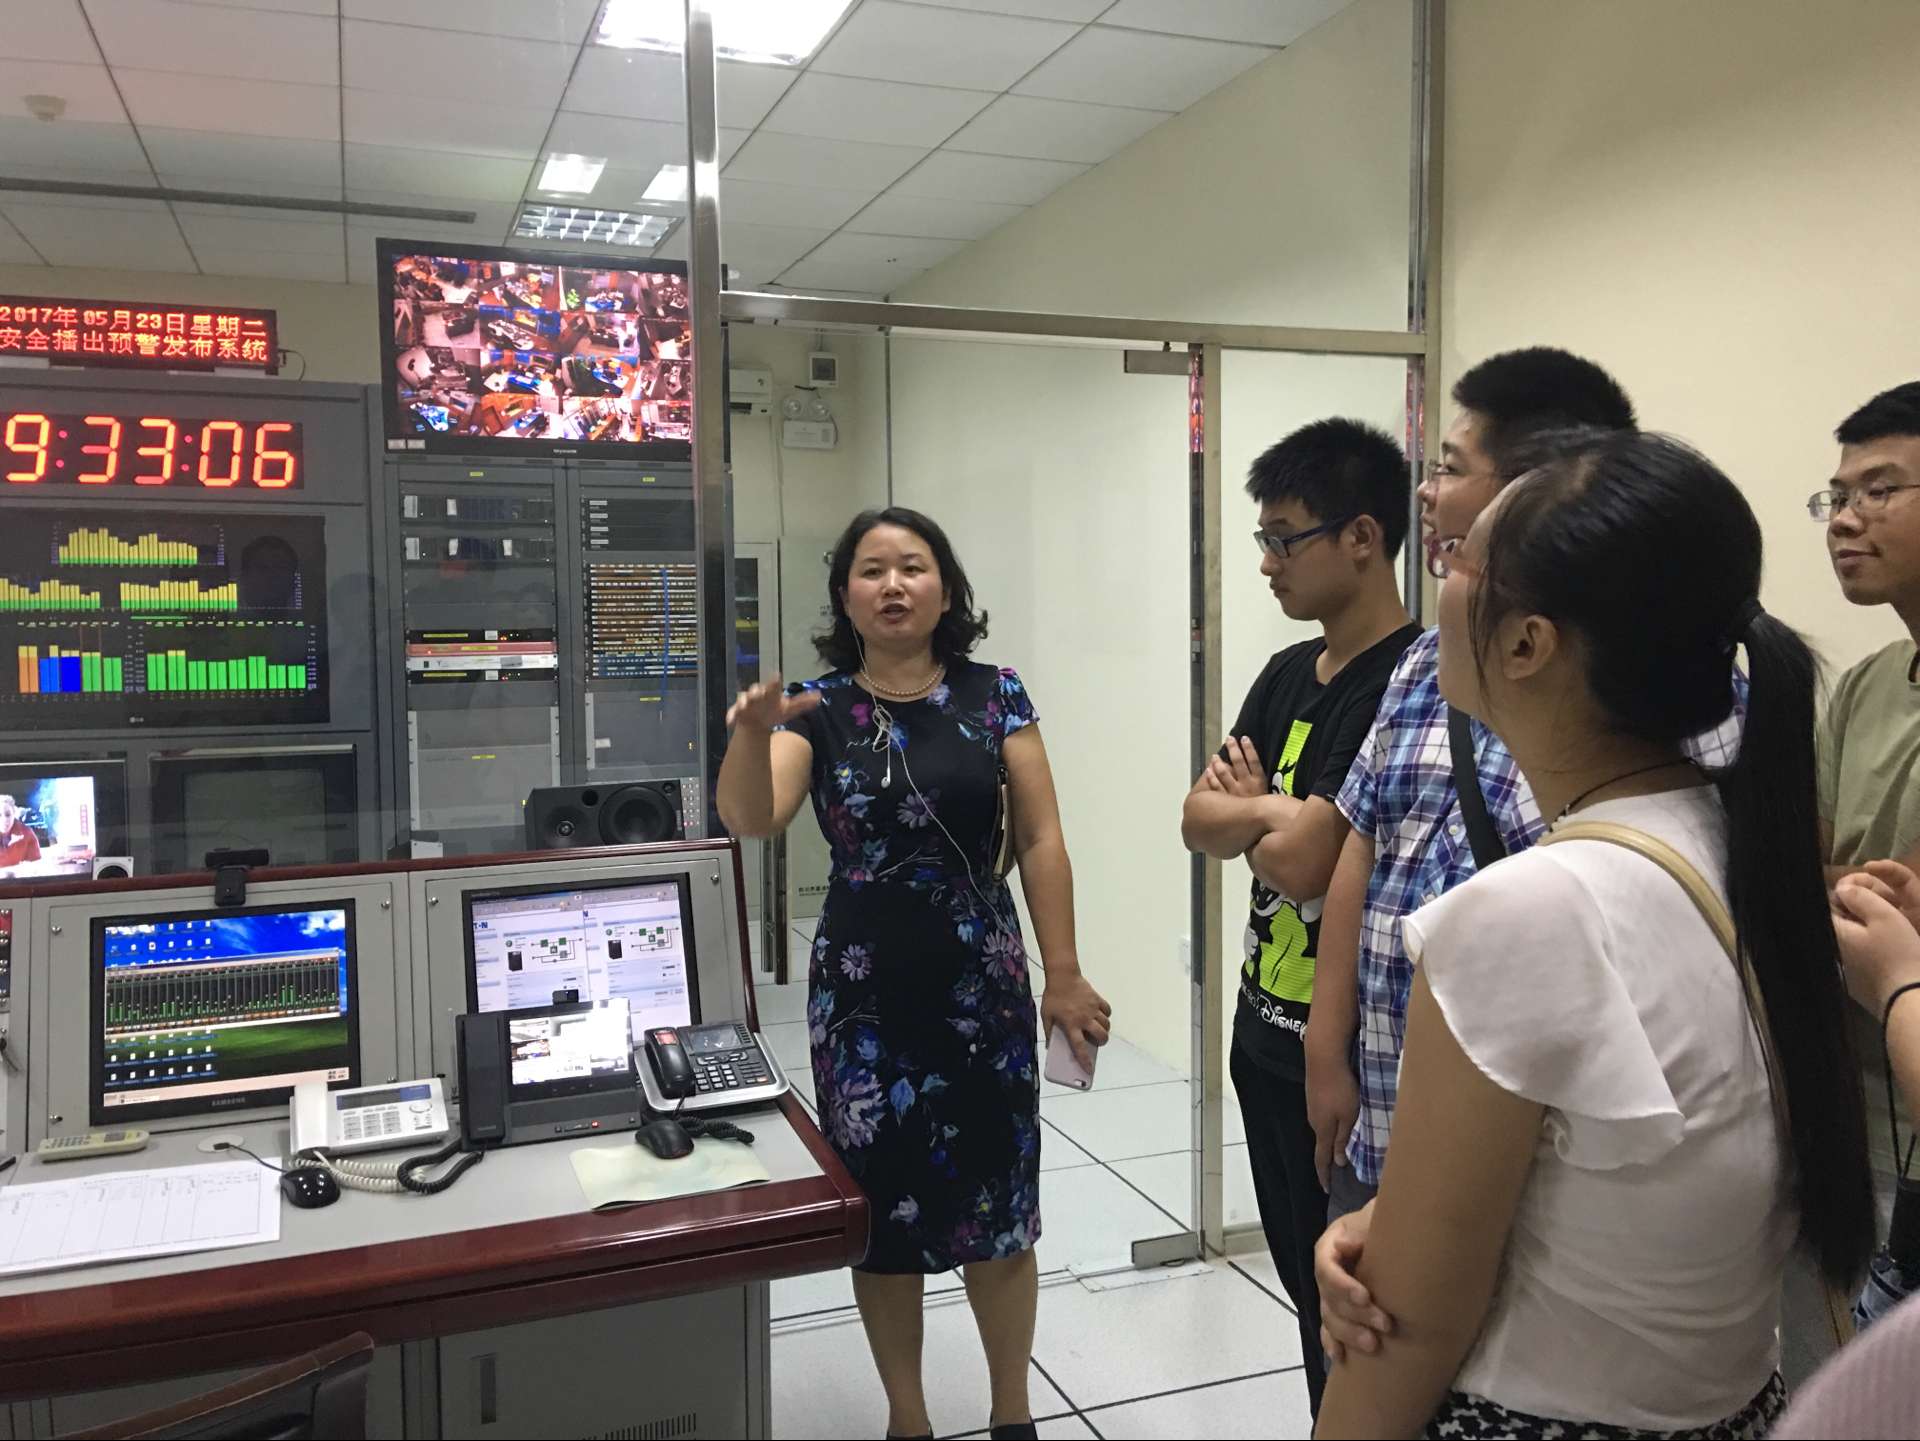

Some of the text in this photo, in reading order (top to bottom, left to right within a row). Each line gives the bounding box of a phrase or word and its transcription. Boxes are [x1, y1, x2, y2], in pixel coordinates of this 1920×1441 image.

[0, 327, 267, 361] 安全播出预警发布系统
[5, 413, 295, 488] 9:33:06
